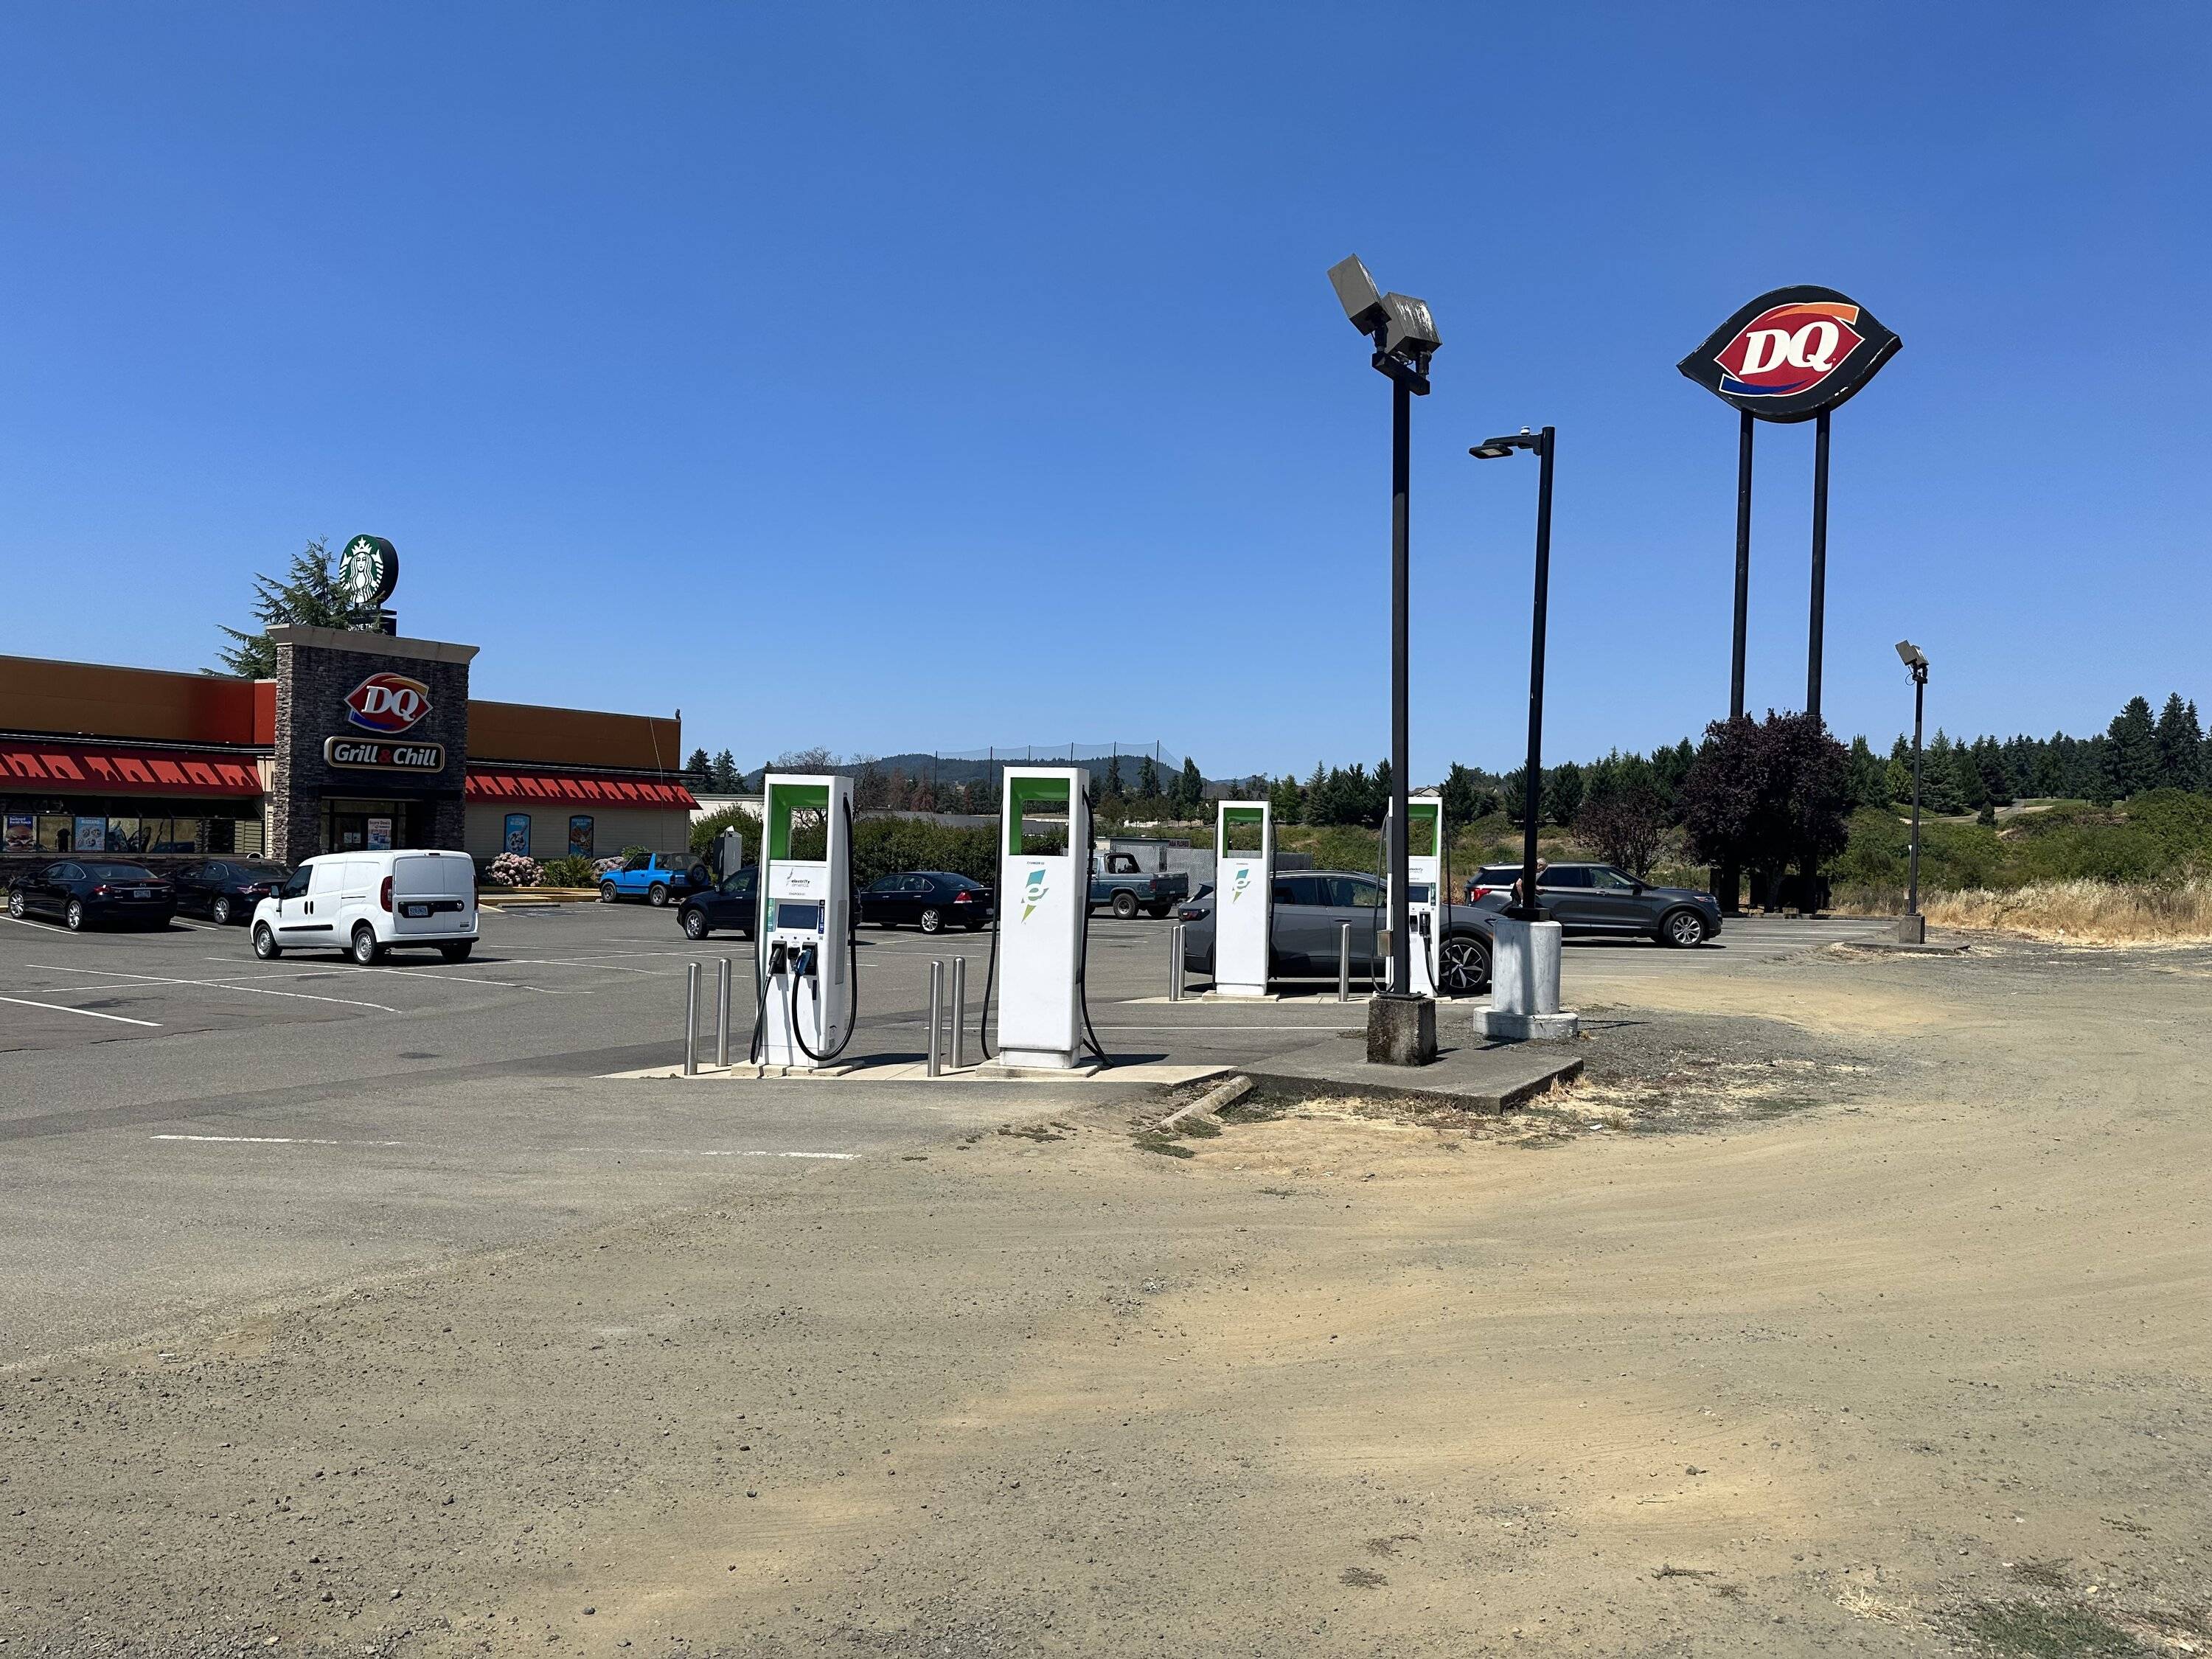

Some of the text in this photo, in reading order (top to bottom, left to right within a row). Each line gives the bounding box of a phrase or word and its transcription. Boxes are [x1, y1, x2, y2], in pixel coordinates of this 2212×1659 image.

[1739, 321, 1840, 375] DQ
[361, 685, 419, 722] DQ
[334, 743, 378, 763] Grill
[393, 748, 437, 766] Chill
